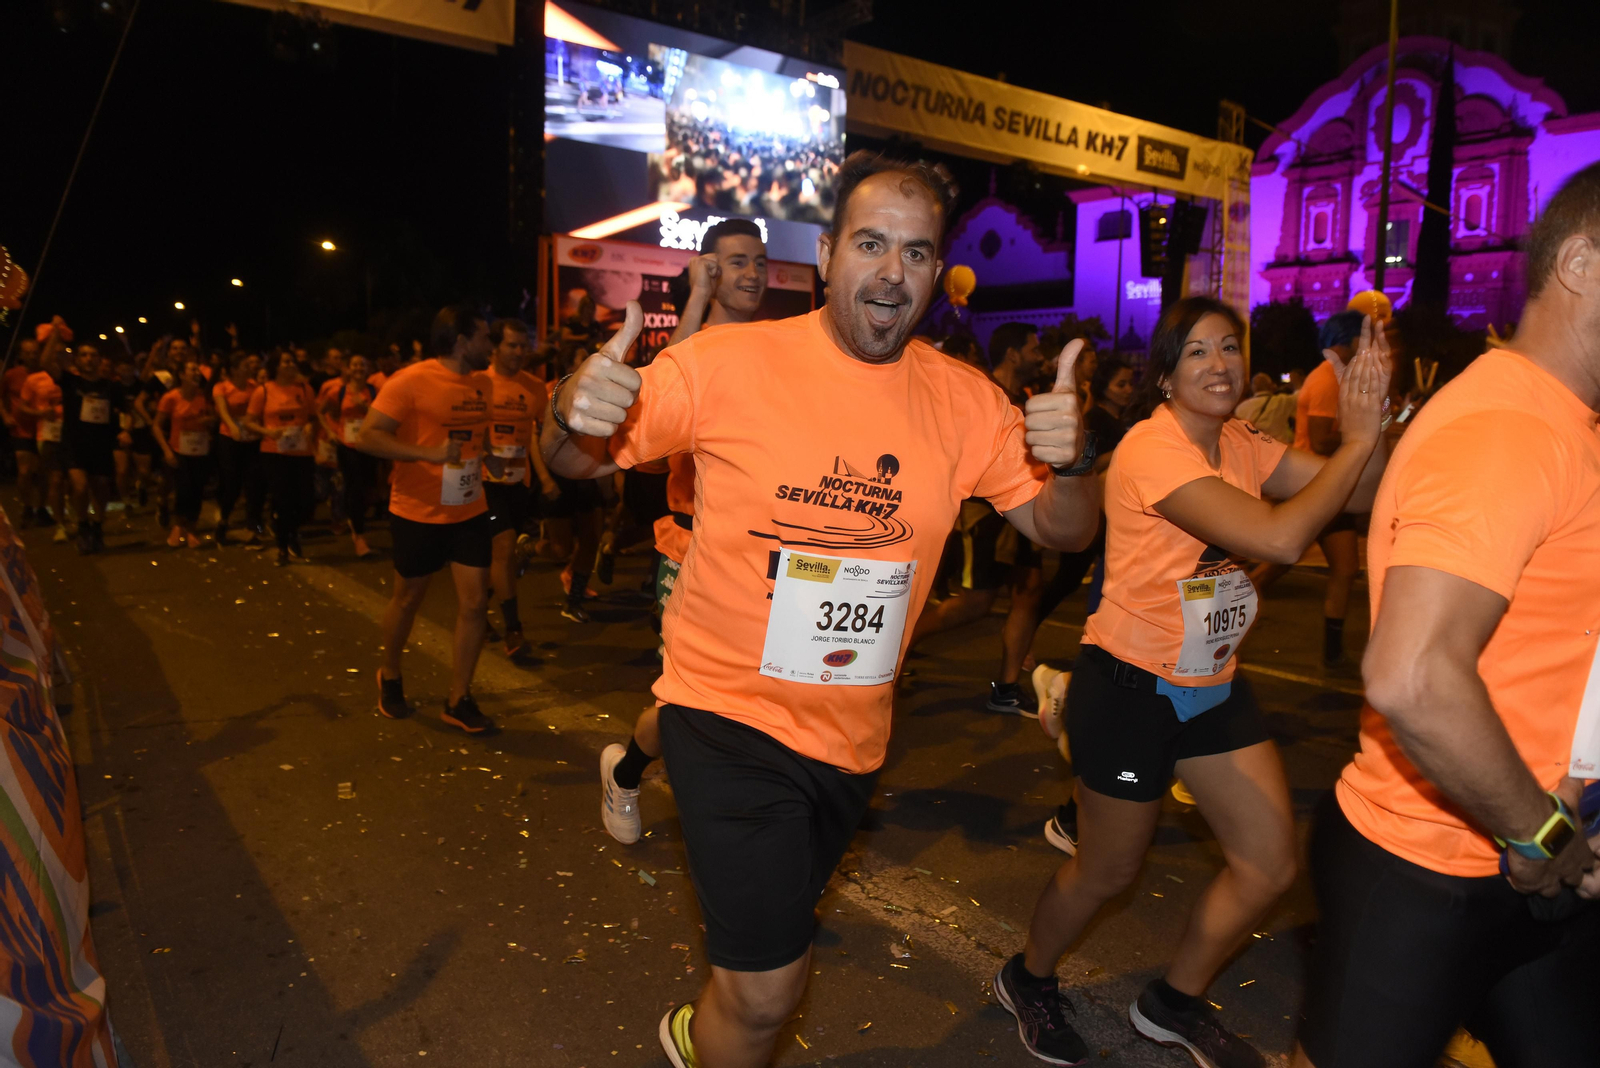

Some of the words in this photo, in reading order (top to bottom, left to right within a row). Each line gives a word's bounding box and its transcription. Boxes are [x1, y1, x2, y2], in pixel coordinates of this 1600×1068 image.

[851, 69, 986, 126] NOCTURNA
[994, 105, 1078, 149] SEVILLA
[1125, 279, 1162, 300] Sevill
[775, 484, 854, 512] SEVILLA
[819, 475, 903, 503] NOCTURNA
[816, 601, 885, 634] 3284
[1204, 604, 1246, 636] 10975
[811, 635, 830, 643] JORGE
[831, 636, 853, 644] TORIBIO
[853, 637, 876, 645] BLANCO
